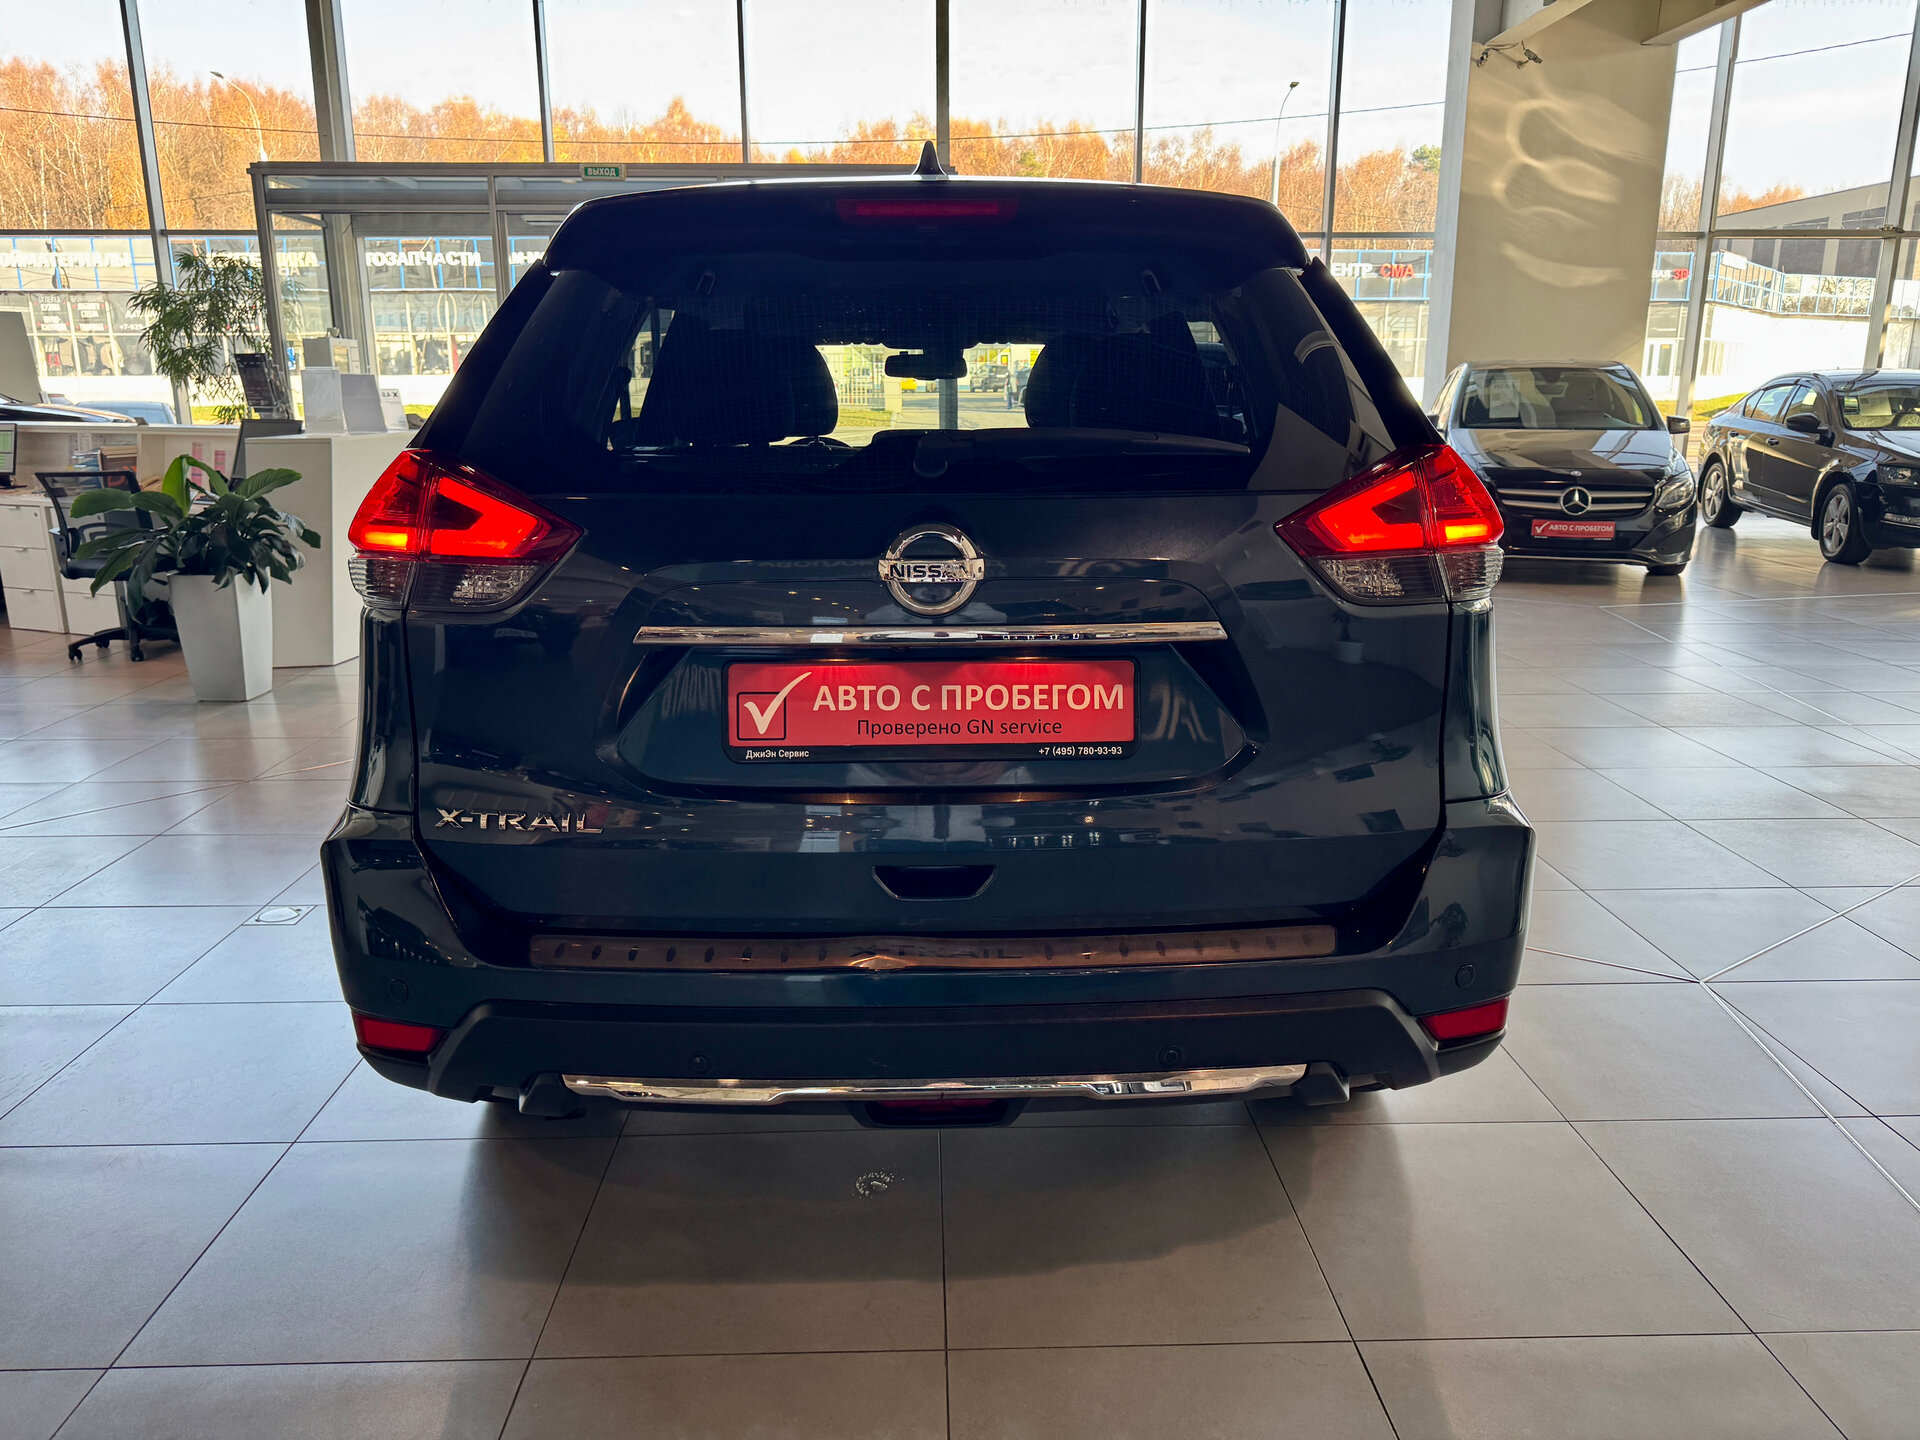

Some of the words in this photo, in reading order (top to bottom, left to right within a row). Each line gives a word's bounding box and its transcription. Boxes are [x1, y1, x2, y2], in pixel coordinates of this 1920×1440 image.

[587, 168, 616, 177] ВЫХОД
[889, 564, 970, 578] NISSAN
[812, 685, 901, 711] АВТО
[911, 684, 931, 711] С
[941, 684, 1124, 711] ПРОБЕГОМ
[857, 720, 961, 738] Проверено
[967, 719, 994, 735] GN
[1000, 719, 1062, 734] service
[745, 750, 777, 760] ДжиЭн
[778, 749, 810, 759] Сервис
[1038, 748, 1050, 756] +7
[1052, 746, 1076, 757] (495)
[1078, 746, 1123, 756] 780-93-93
[435, 807, 603, 833] X-TRAIL
